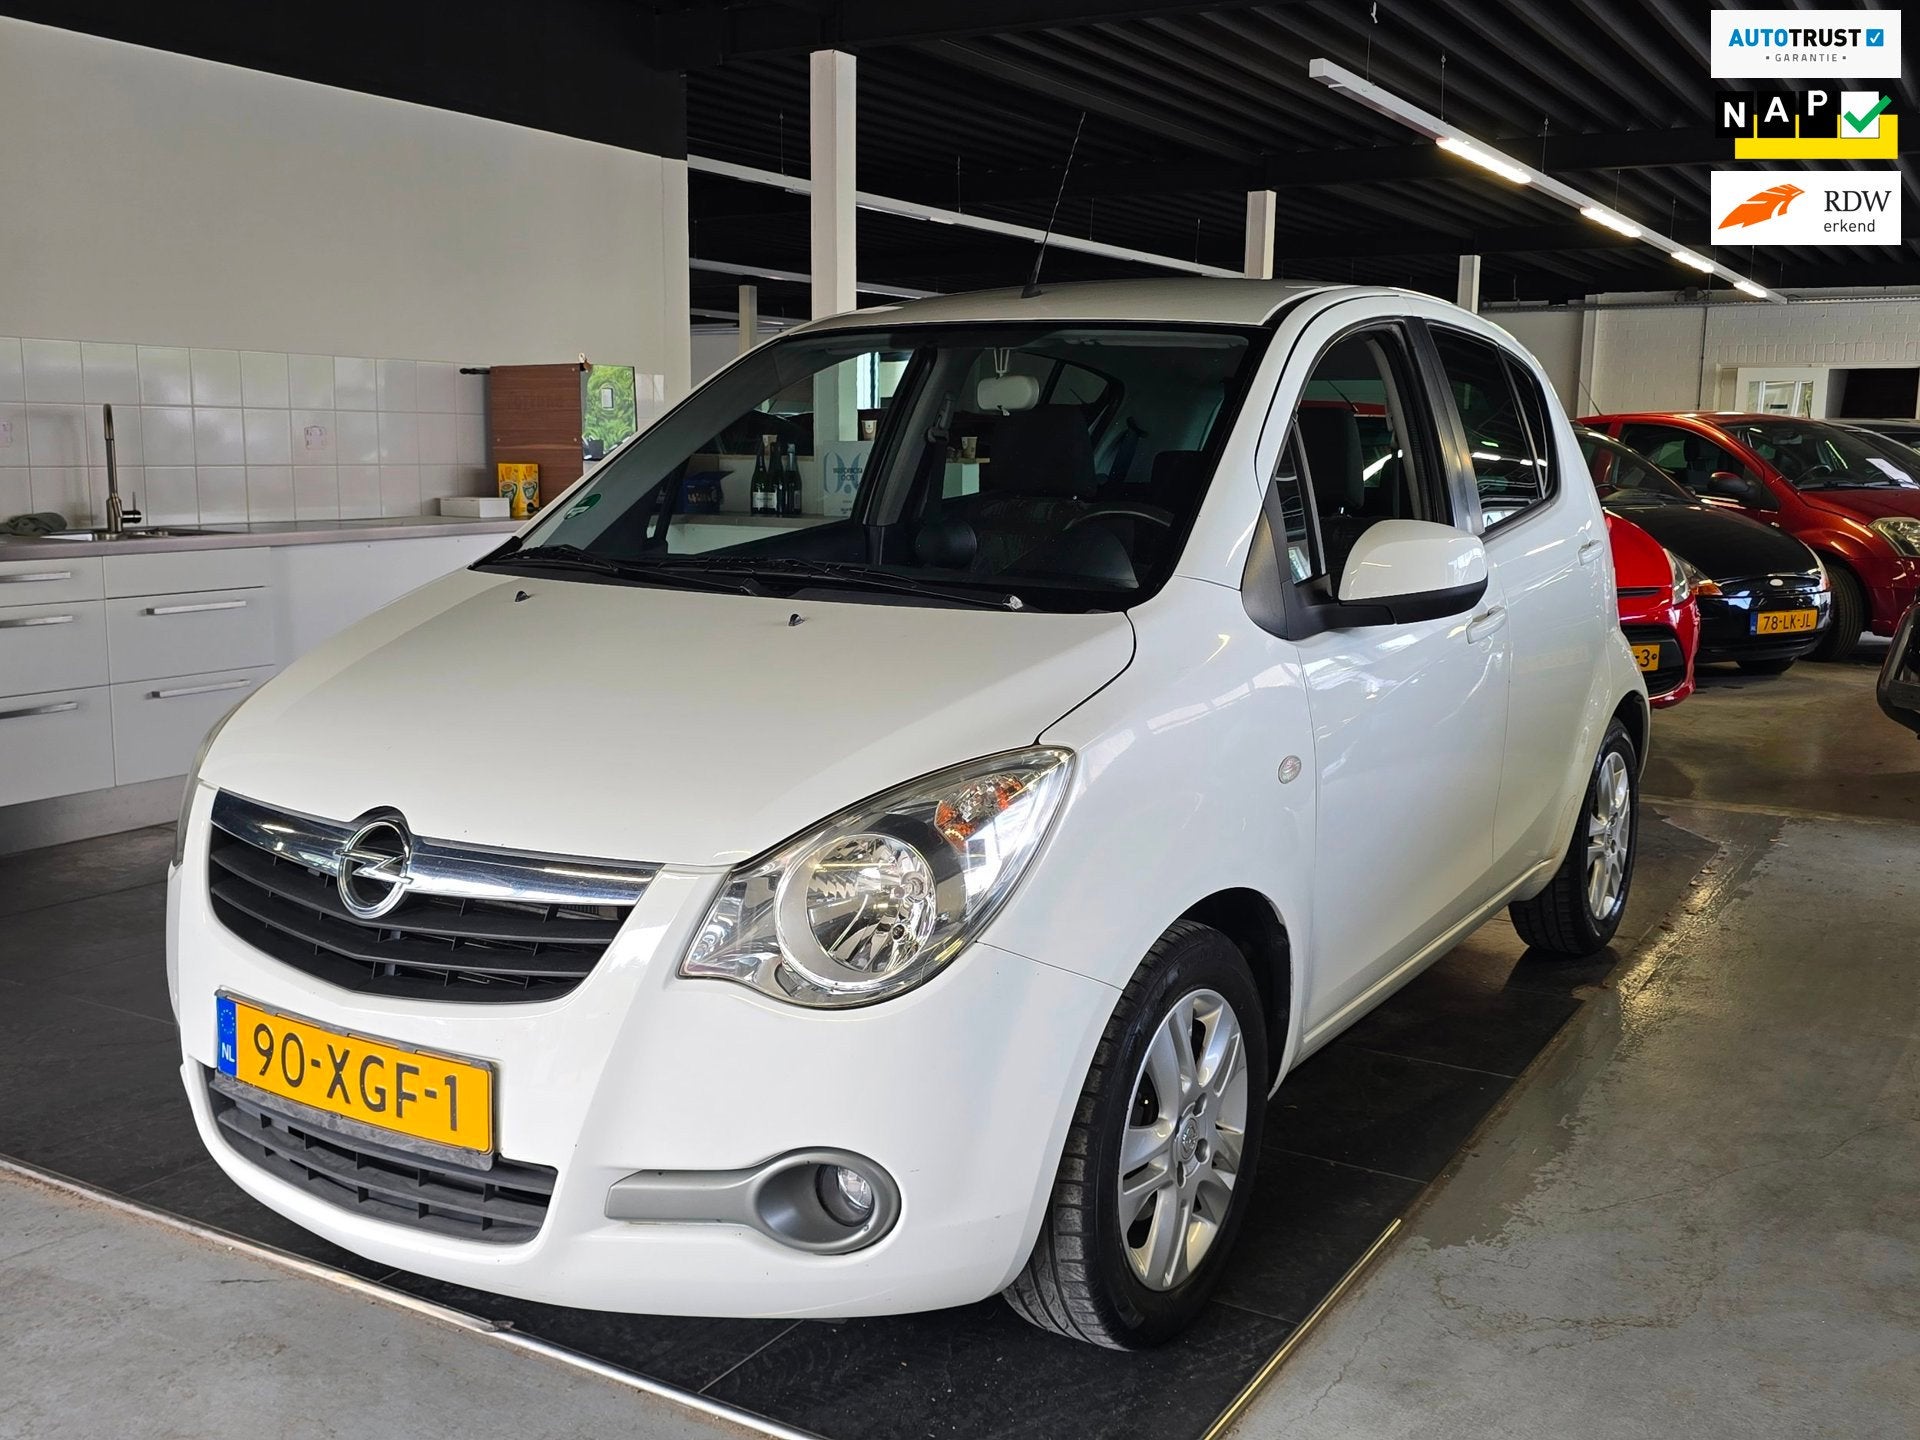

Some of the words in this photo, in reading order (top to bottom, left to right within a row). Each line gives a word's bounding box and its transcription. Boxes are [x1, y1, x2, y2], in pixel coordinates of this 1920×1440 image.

[1763, 613, 1811, 631] 78-LK-JL
[221, 1043, 235, 1062] NL
[253, 1023, 458, 1132] 90-XGF-1
